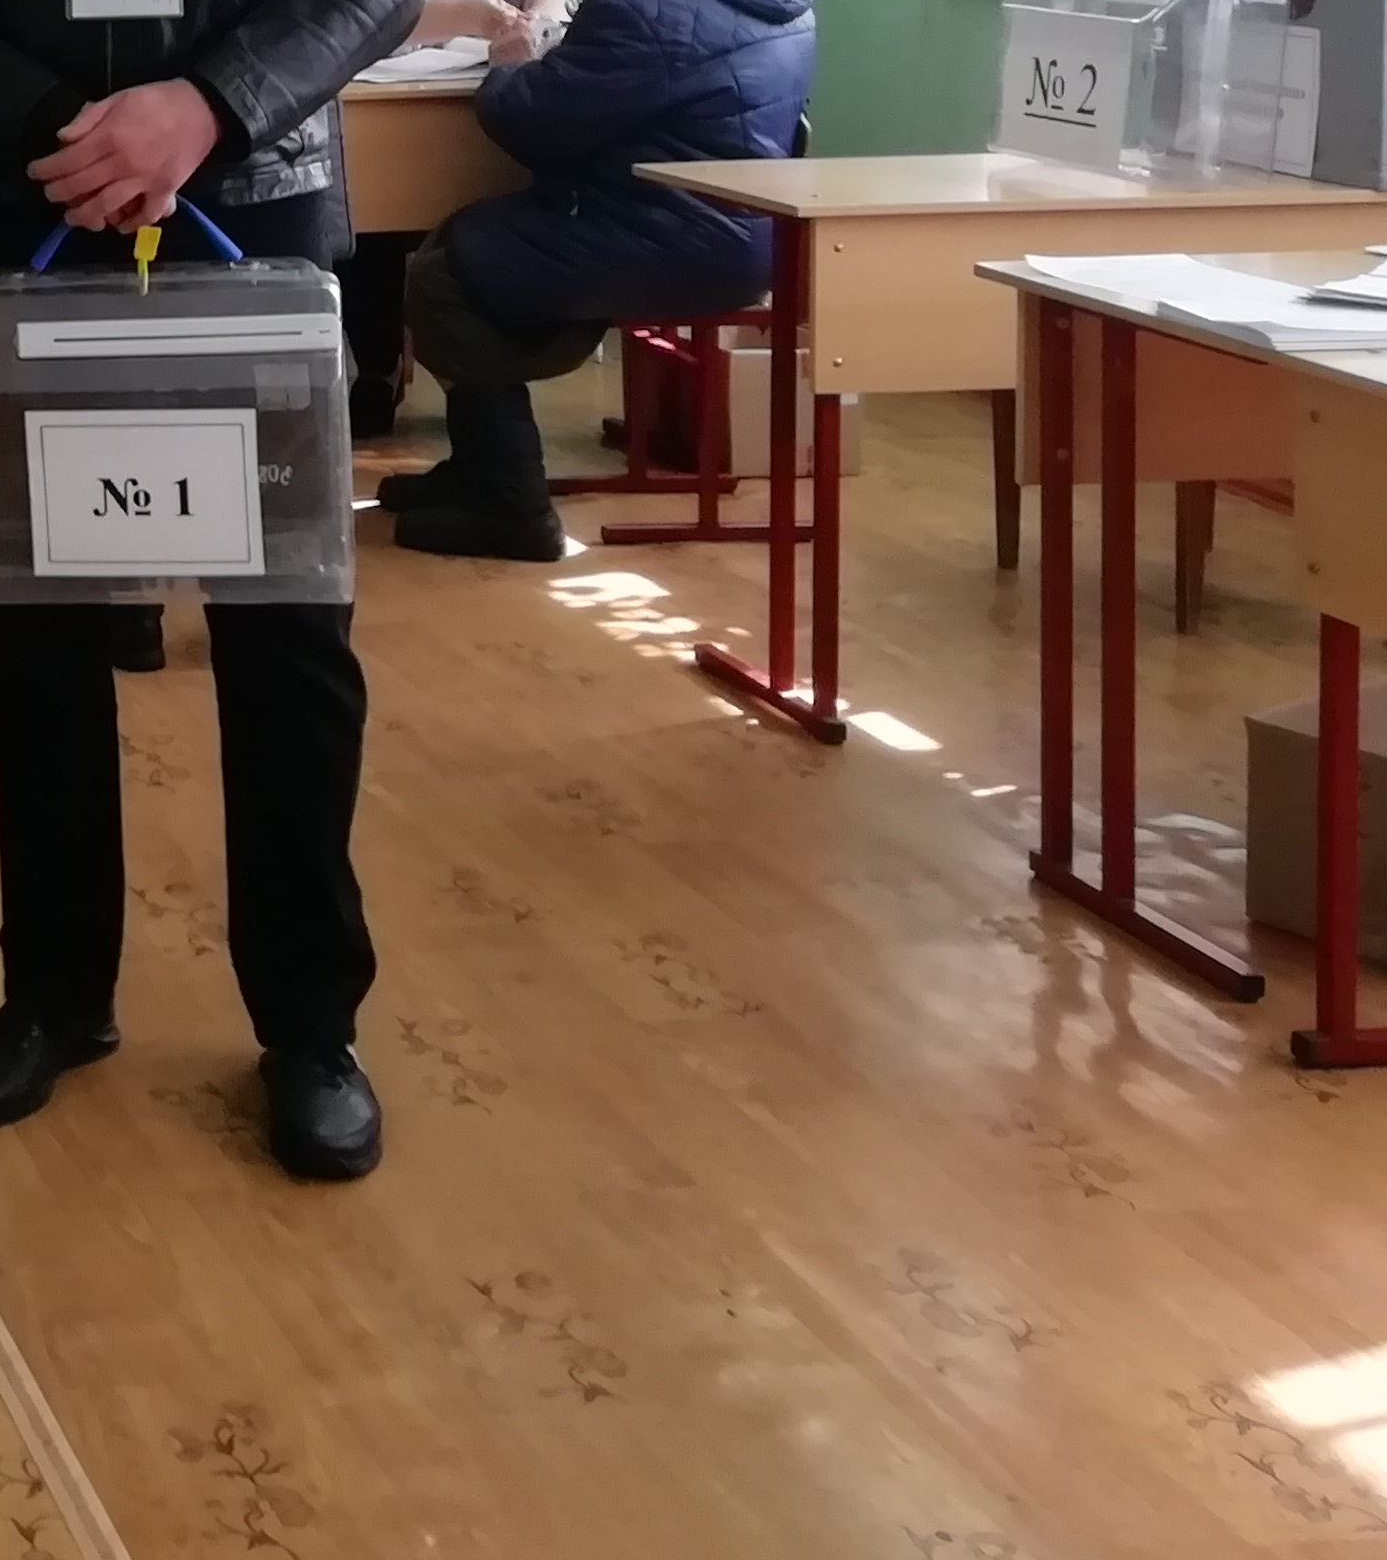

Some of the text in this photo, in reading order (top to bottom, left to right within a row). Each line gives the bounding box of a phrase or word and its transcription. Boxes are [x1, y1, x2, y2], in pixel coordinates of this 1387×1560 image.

[1026, 56, 1098, 116] № 2
[93, 476, 195, 517] № 1
